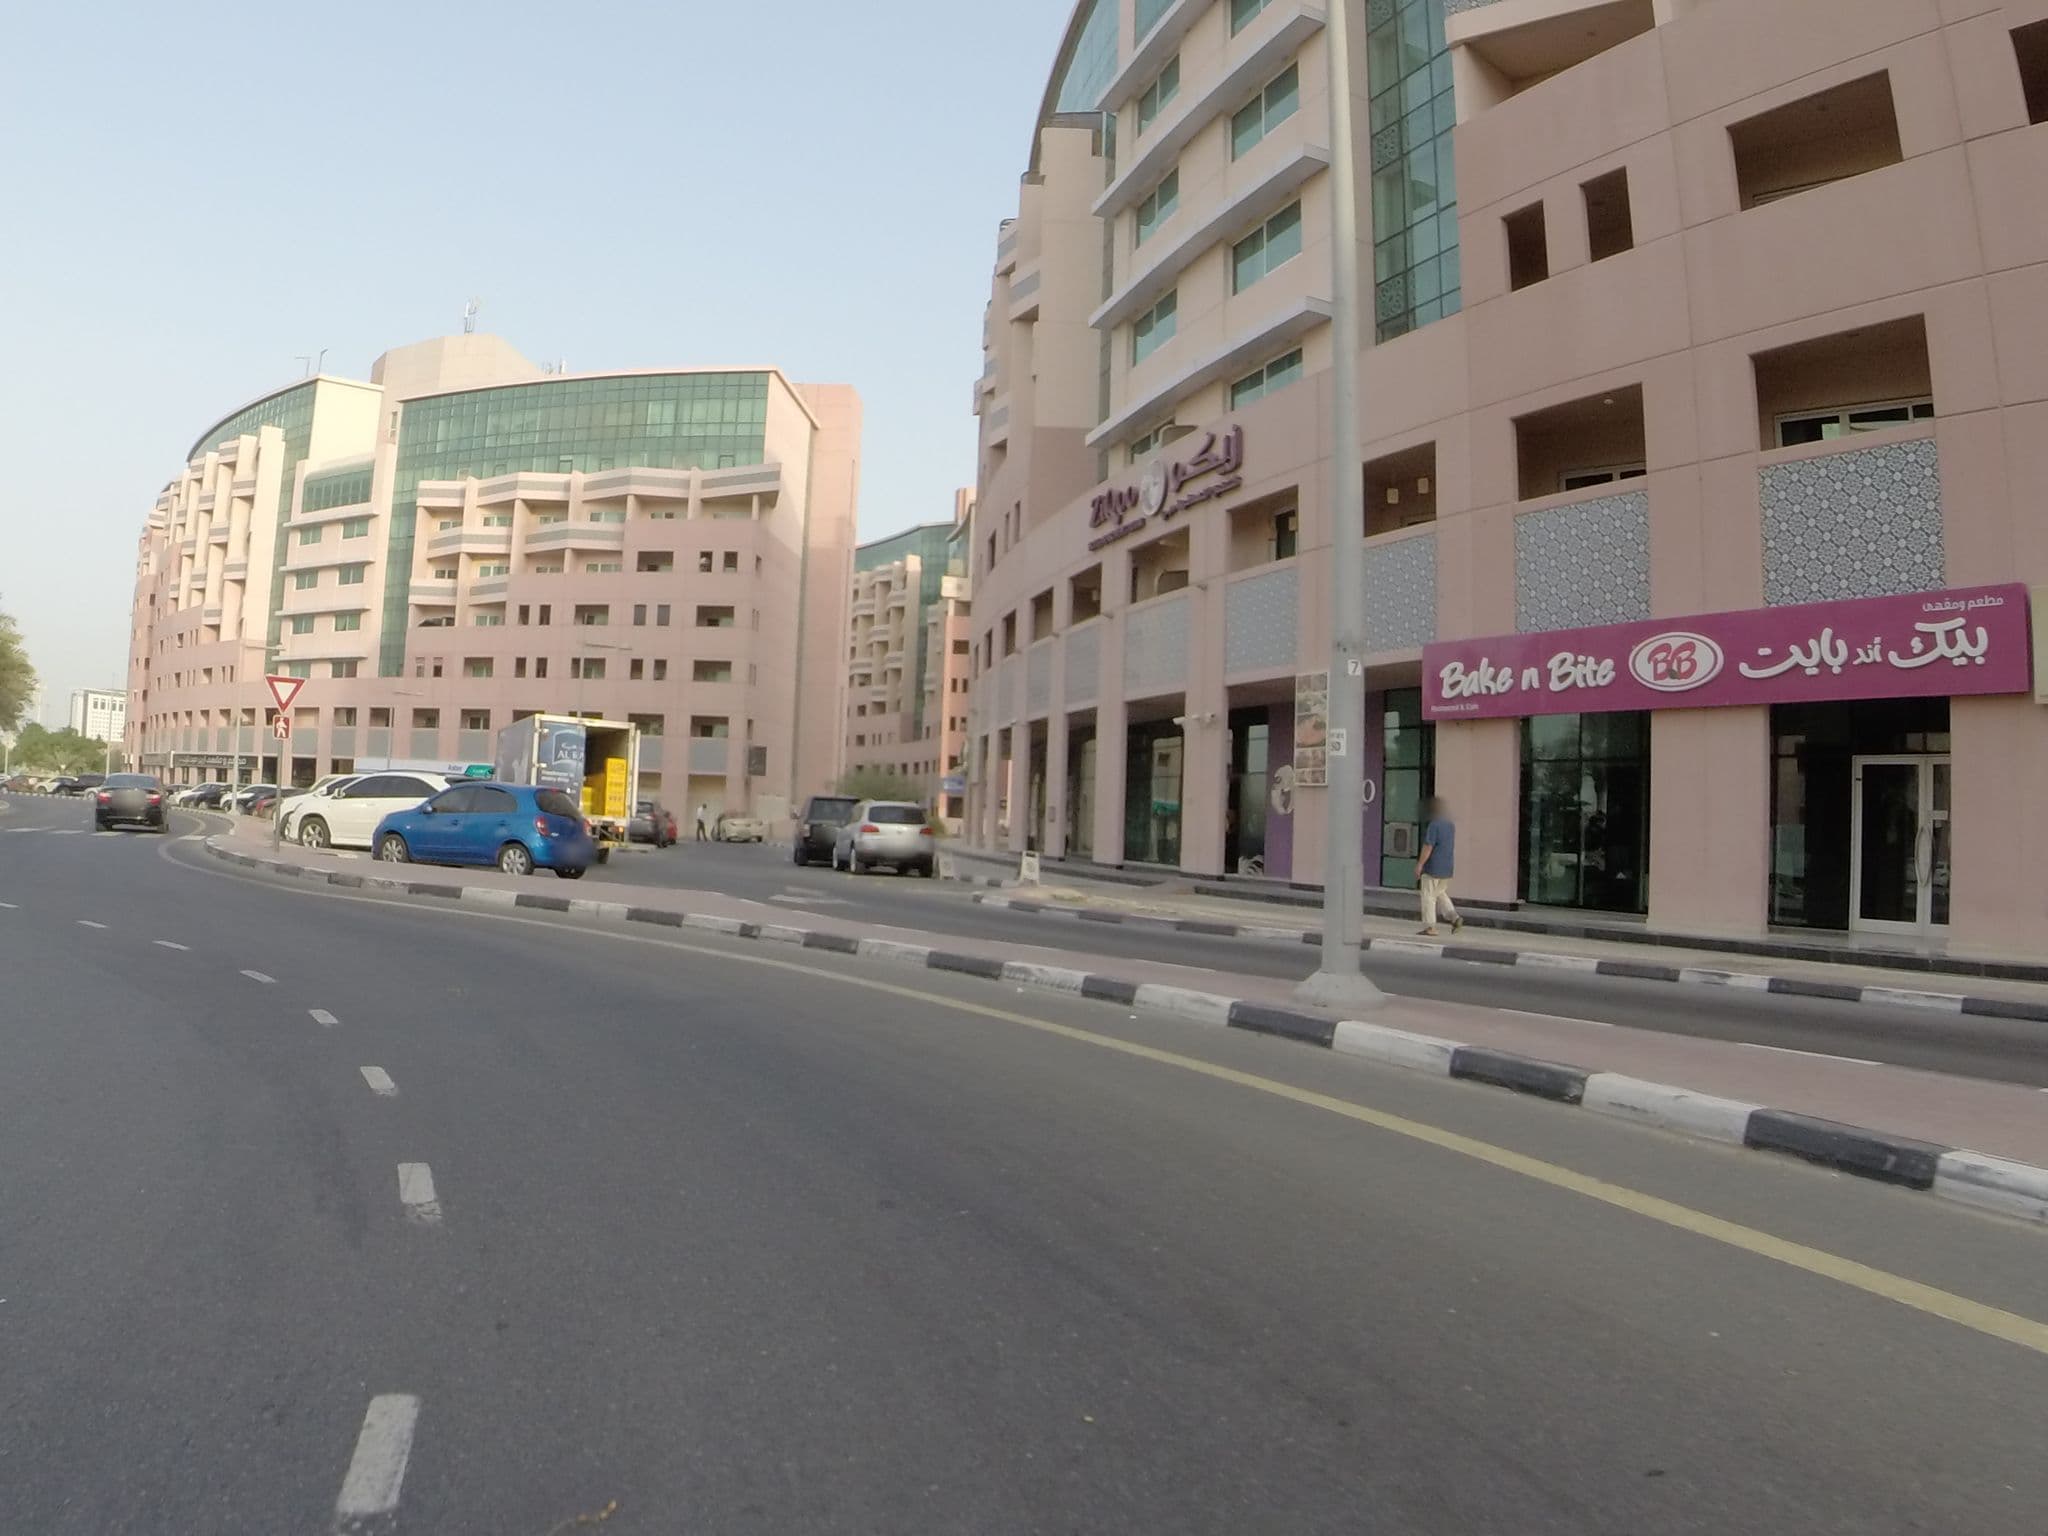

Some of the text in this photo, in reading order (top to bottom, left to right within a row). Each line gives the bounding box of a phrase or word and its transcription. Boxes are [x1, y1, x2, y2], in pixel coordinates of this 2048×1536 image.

[1967, 595, 2004, 611] مطعم
[1350, 660, 1359, 674] 7
[1738, 627, 1849, 679] بايت
[1887, 617, 1989, 669] بيك
[1439, 651, 1616, 699] Bake n Bite
